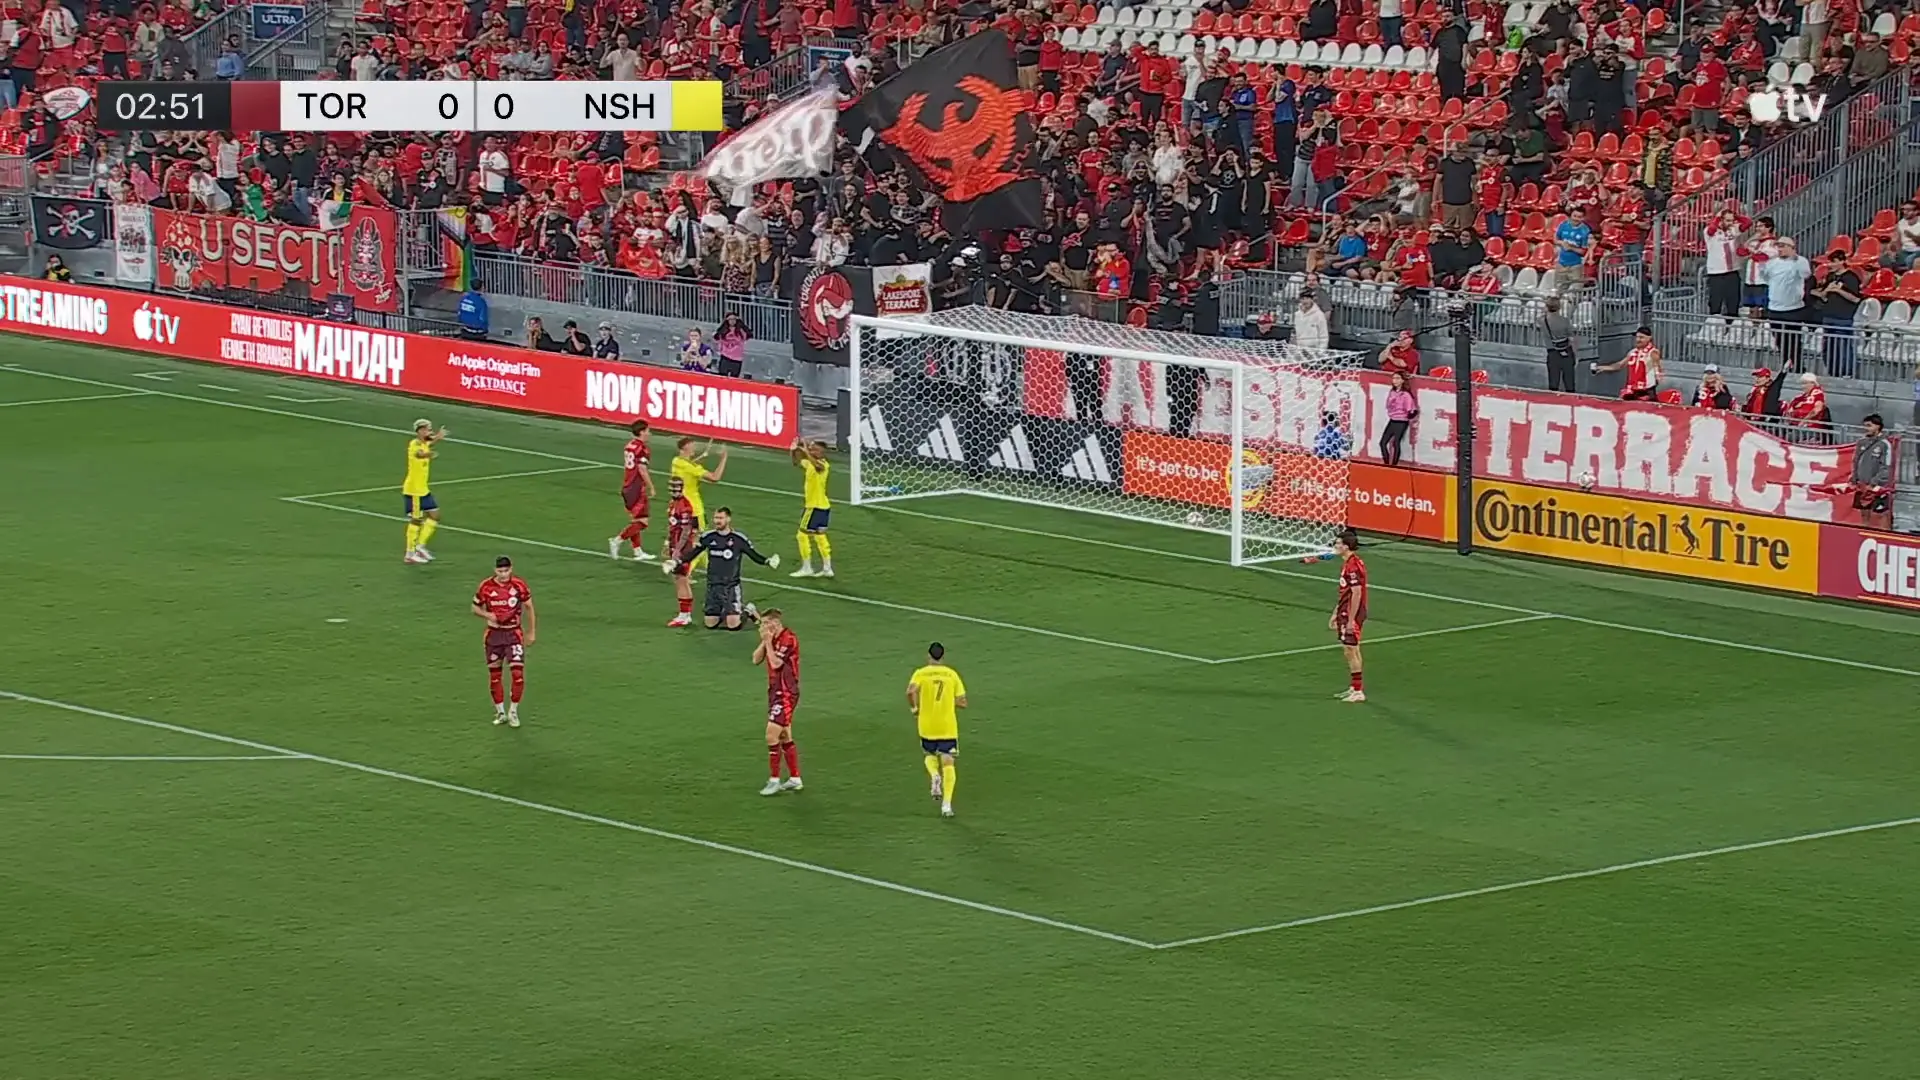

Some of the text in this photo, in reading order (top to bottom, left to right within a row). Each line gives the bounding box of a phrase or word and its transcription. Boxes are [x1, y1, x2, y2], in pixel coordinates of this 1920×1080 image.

[261, 14, 297, 25] ULTRA
[200, 218, 223, 261] U
[884, 299, 921, 310] TERRACE
[151, 305, 181, 345] tv
[230, 313, 252, 336] RYAN
[252, 316, 293, 342] REYNOLDS
[220, 337, 256, 362] KENNETH
[294, 321, 405, 385] MAYDAY
[447, 352, 541, 377] An Apple Original Film
[461, 373, 527, 396] by SKYDANCE
[585, 369, 784, 437] NOW STREAMING
[1476, 395, 1839, 523] TERRACE
[1201, 467, 1220, 482] be
[1354, 487, 1370, 504] to
[1373, 488, 1392, 507] be
[1395, 493, 1437, 516] clean,
[1475, 488, 1790, 571] Continental Tire
[511, 643, 524, 656] 13
[932, 679, 945, 702] 7
